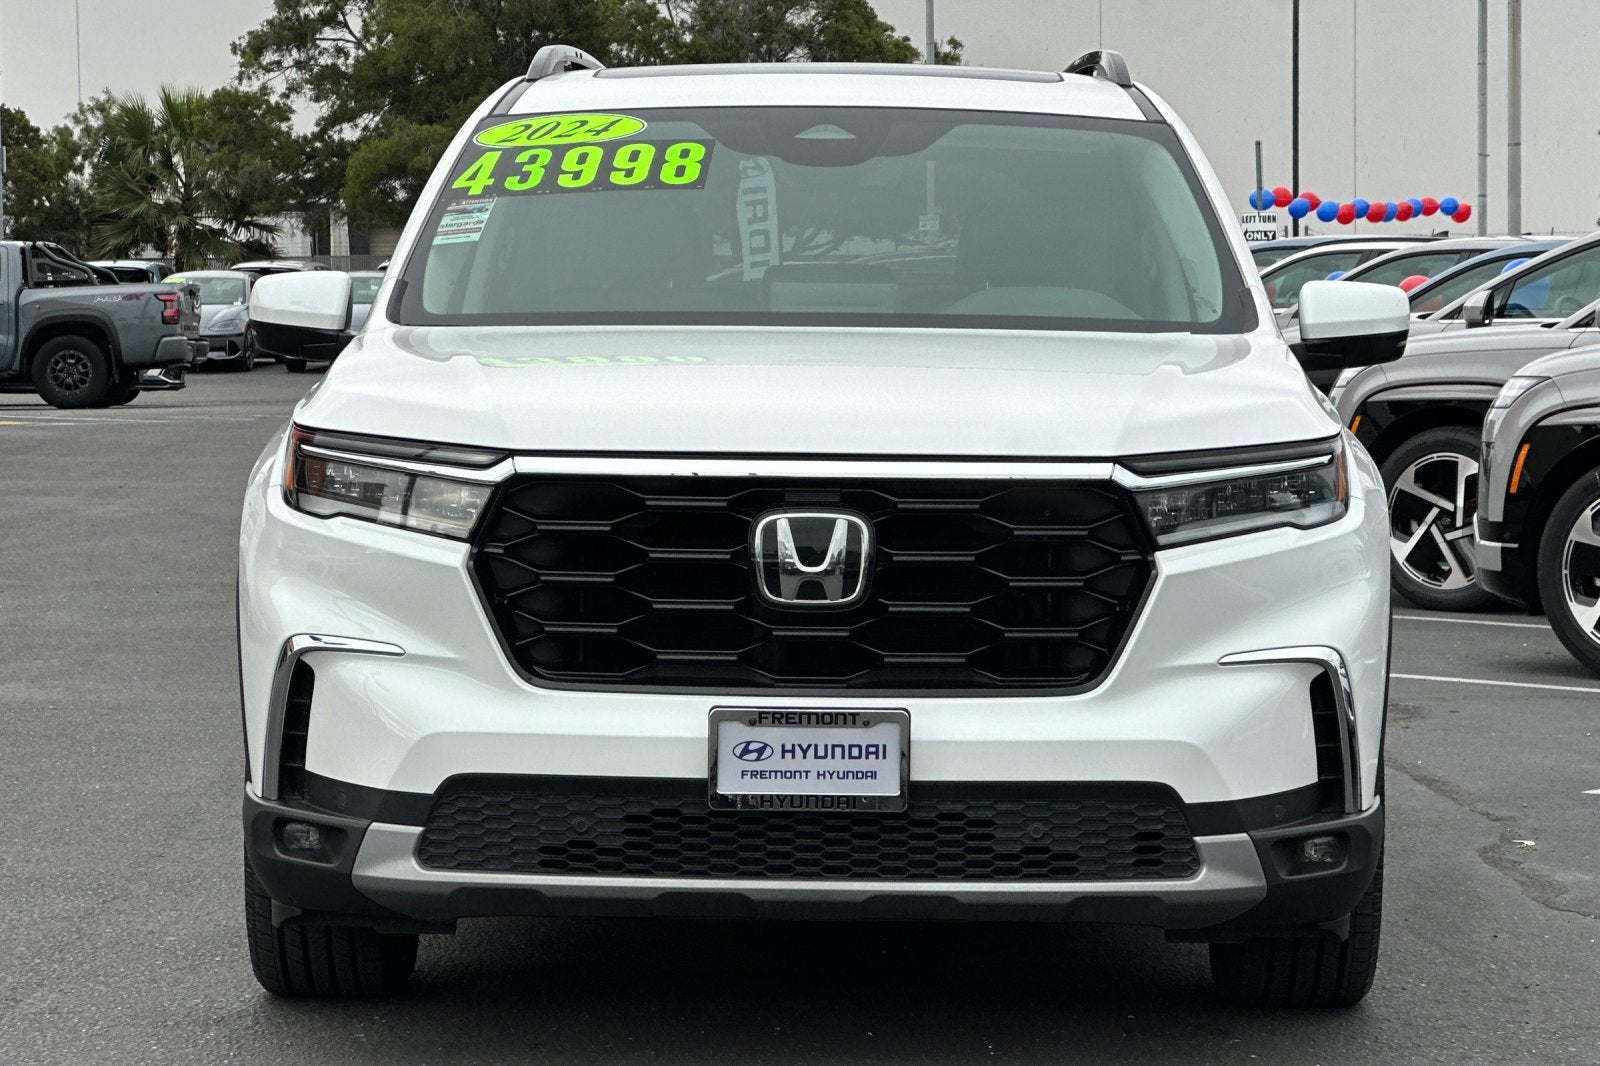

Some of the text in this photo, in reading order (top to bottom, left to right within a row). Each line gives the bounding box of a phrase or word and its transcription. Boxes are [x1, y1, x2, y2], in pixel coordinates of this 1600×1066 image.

[495, 118, 623, 144] 2024
[451, 142, 706, 196] 43998
[1242, 215, 1276, 223] LEFT TURN
[1246, 231, 1274, 240] ONLY
[758, 711, 860, 726] FREMONT
[780, 743, 887, 760] HYUNDAI
[740, 769, 877, 780] FREMONT HYUNDAI
[760, 794, 857, 810] HYUNDAI
